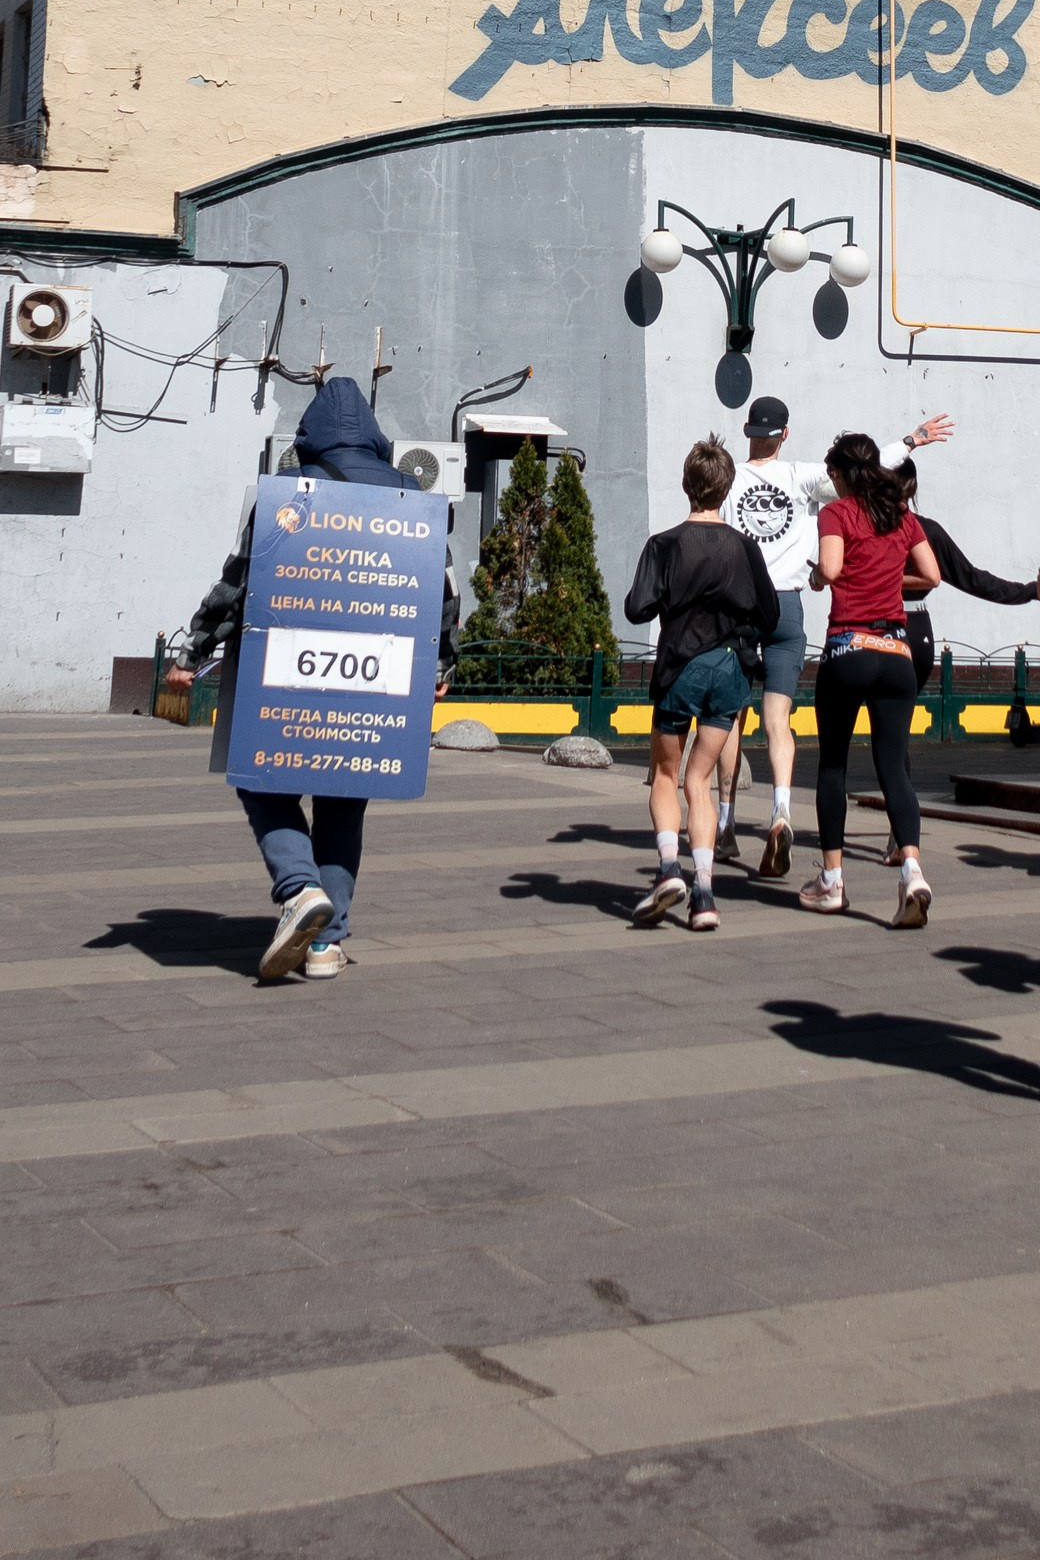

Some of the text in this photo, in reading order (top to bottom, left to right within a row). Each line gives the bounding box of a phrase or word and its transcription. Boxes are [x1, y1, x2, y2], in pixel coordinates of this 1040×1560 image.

[309, 513, 431, 539] LION GOLD
[306, 545, 392, 568] СКУПКА
[275, 565, 419, 588] ЗОЛОТА СЕРЕБРА
[271, 595, 417, 618] ЦЕНА НА ЛОМ 585
[296, 649, 380, 681] 6700
[259, 706, 406, 728] ВСЕГДА ВЫСОКАЯ
[282, 725, 381, 743] СТОИМОСТЬ
[254, 751, 403, 774] 8-915-277-88-88
